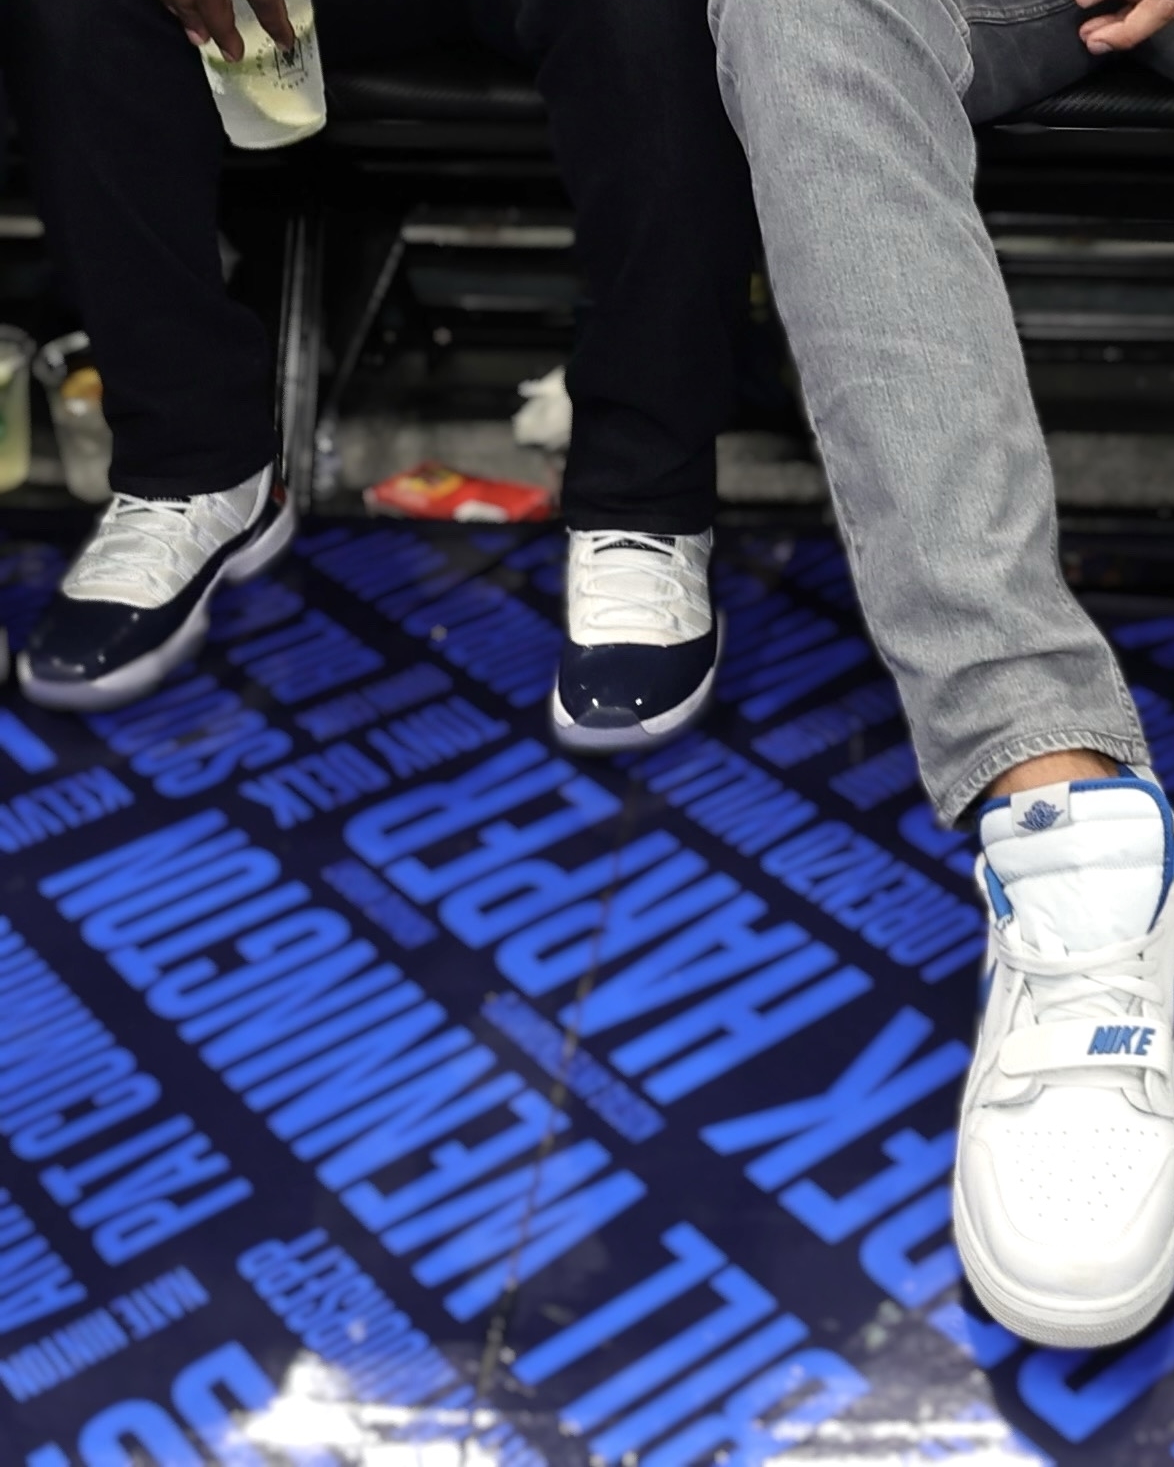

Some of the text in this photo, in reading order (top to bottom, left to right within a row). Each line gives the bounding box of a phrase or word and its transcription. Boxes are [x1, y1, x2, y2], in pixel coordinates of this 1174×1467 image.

[230, 740, 401, 831] DELK
[345, 693, 519, 781] TONY
[323, 736, 882, 1109] HARPER
[28, 805, 652, 1328] WENNINGTON
[1086, 1024, 1156, 1056] NIKE
[33, 1103, 259, 1272] PAT
[102, 1261, 214, 1345] NATE
[482, 1218, 879, 1467] BILL
